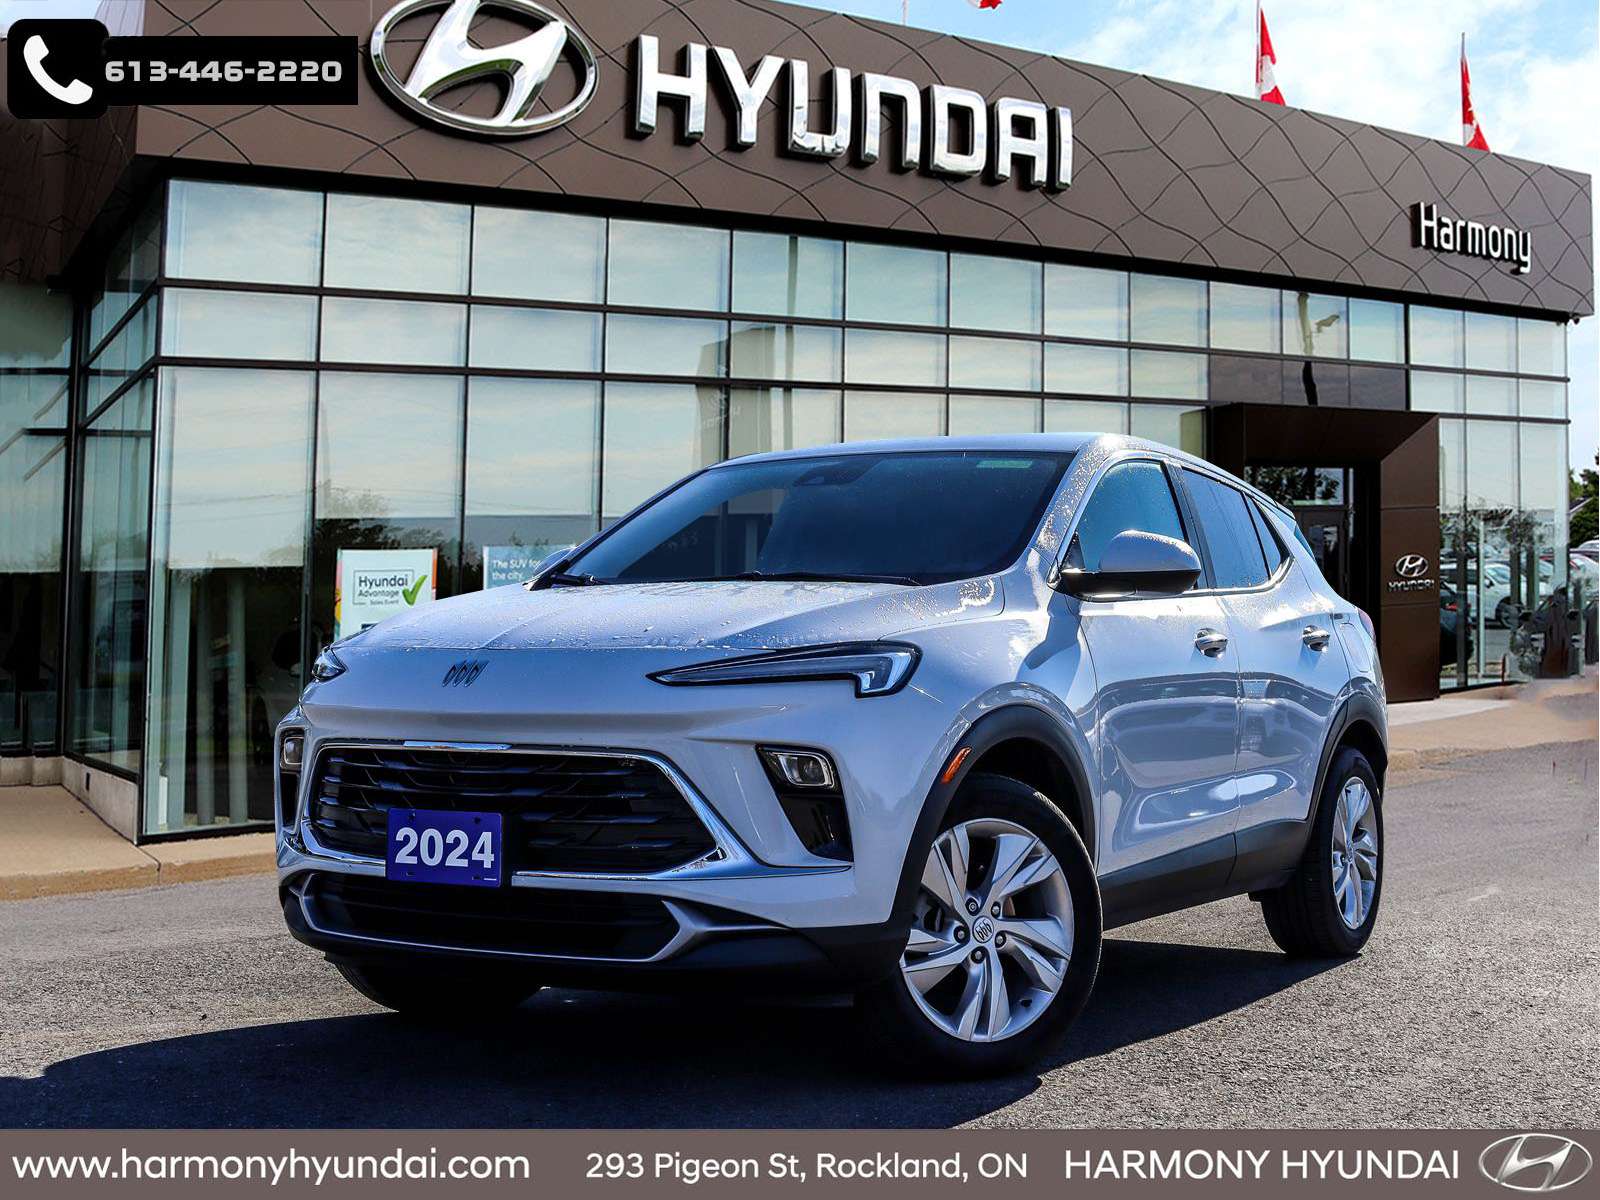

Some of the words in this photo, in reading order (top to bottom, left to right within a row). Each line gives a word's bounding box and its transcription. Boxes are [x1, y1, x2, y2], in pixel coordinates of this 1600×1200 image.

[635, 33, 1074, 191] HYUNDAI
[1418, 201, 1532, 274] Harmony
[492, 559, 509, 569] The
[510, 559, 528, 569] SUV
[358, 574, 409, 589] Hyundai
[492, 572, 506, 580] the
[358, 589, 400, 598] Advantage
[395, 826, 495, 869] 2024
